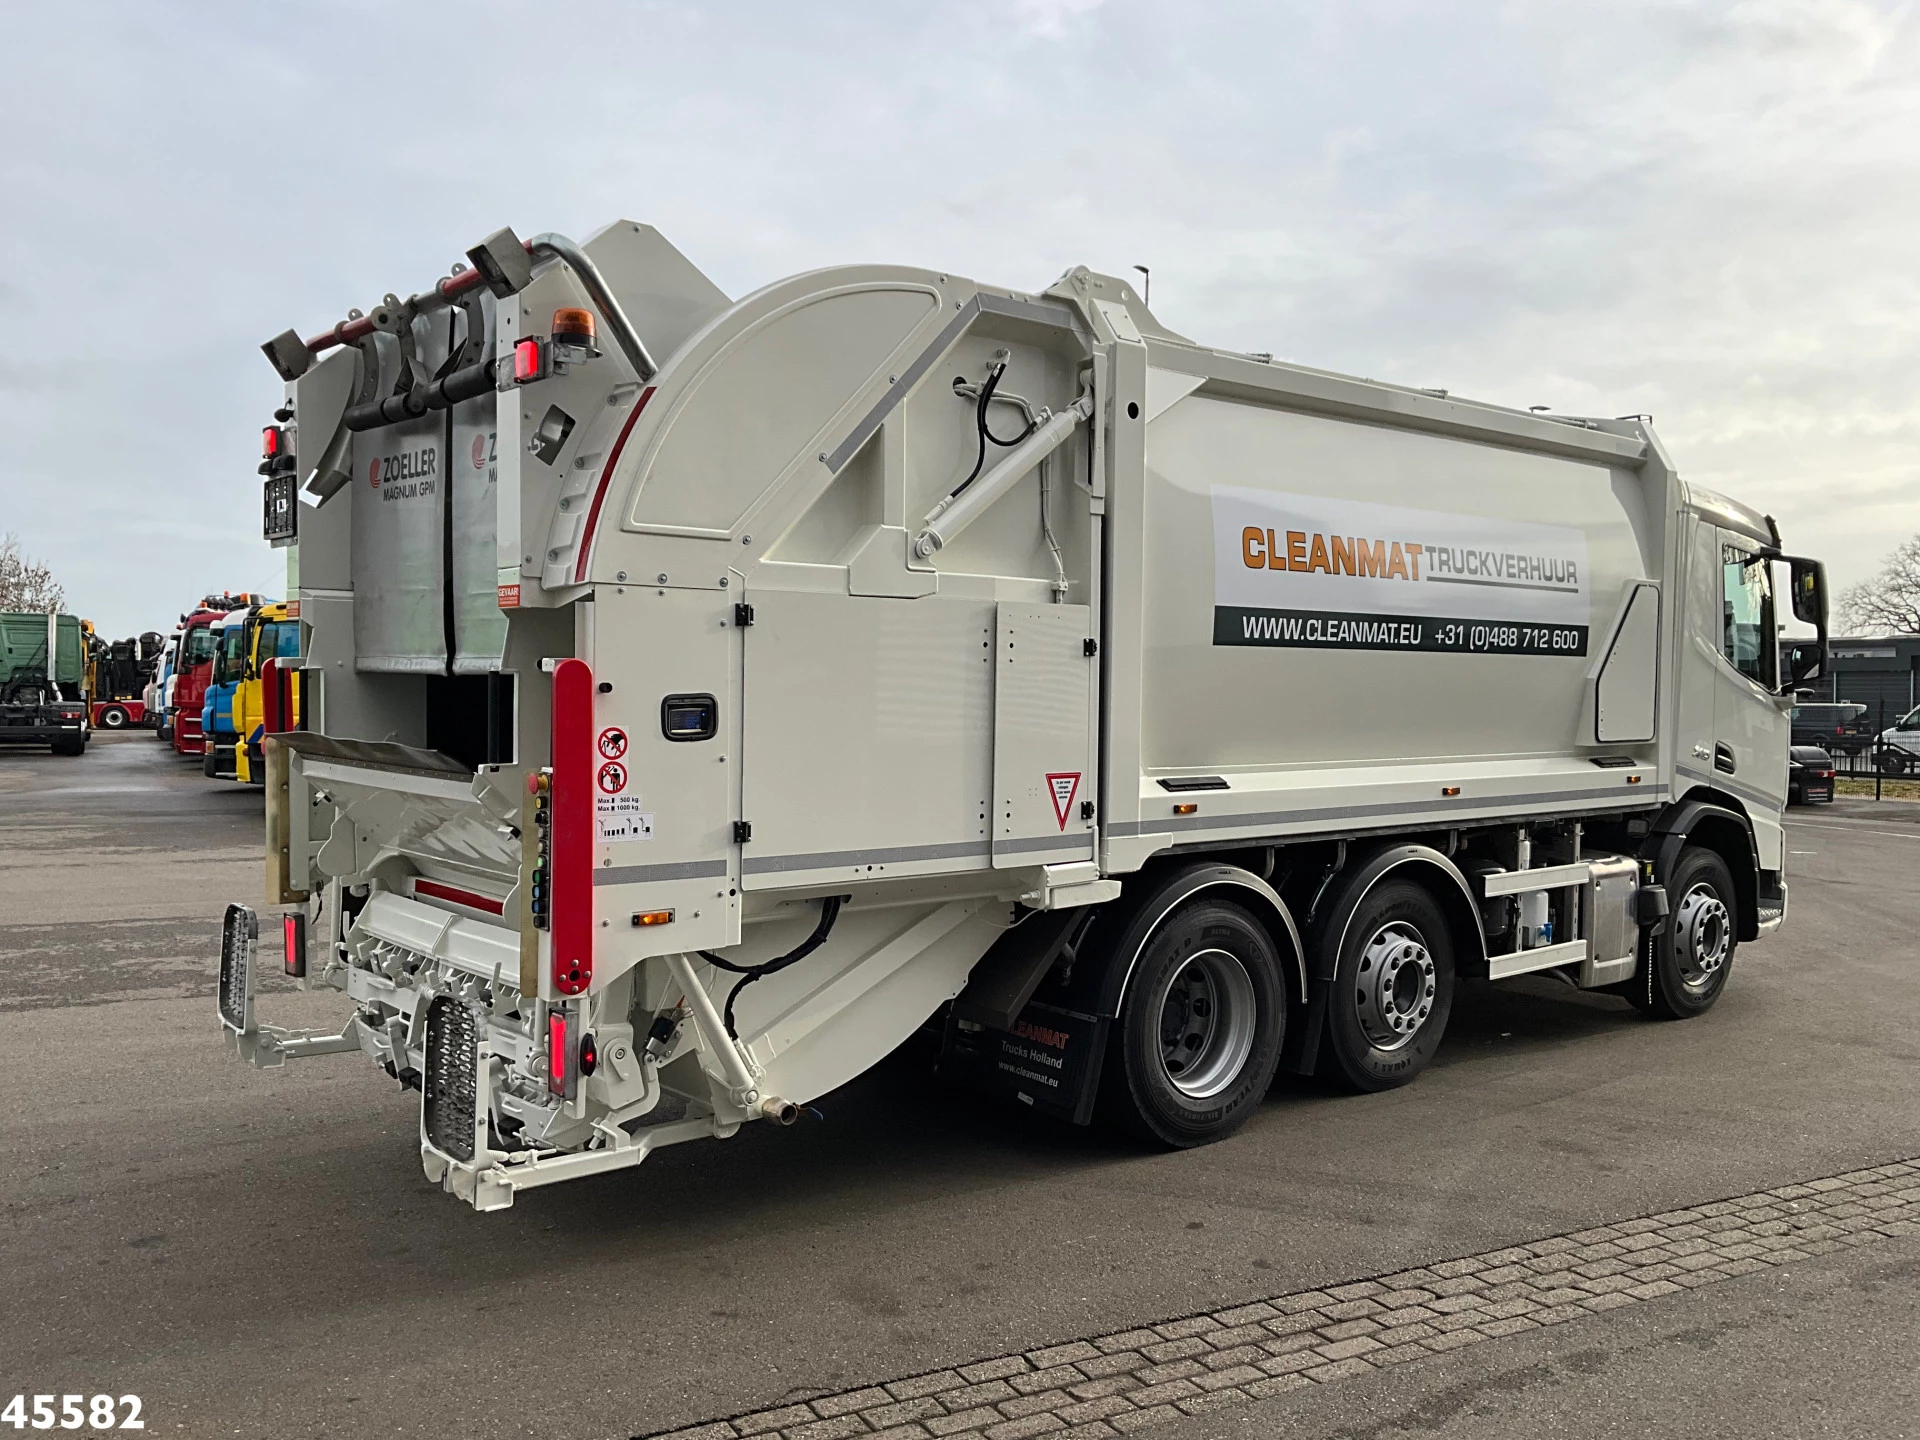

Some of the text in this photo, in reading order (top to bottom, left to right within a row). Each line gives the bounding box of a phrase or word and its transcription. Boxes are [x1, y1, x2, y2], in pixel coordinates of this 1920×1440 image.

[383, 448, 436, 483] ZOELLER
[383, 480, 436, 501] MAGNUM GPM
[1242, 526, 1578, 584] CLEANMAT TRUCKVERHUUR
[1242, 615, 1579, 650] WWW.CLEANMAT.EU +31 (0)488 712 600
[1009, 1020, 1069, 1050] LEANMAT
[1001, 1039, 1063, 1069] Trucks Holland
[998, 1060, 1059, 1087] www.cleanmat.eu
